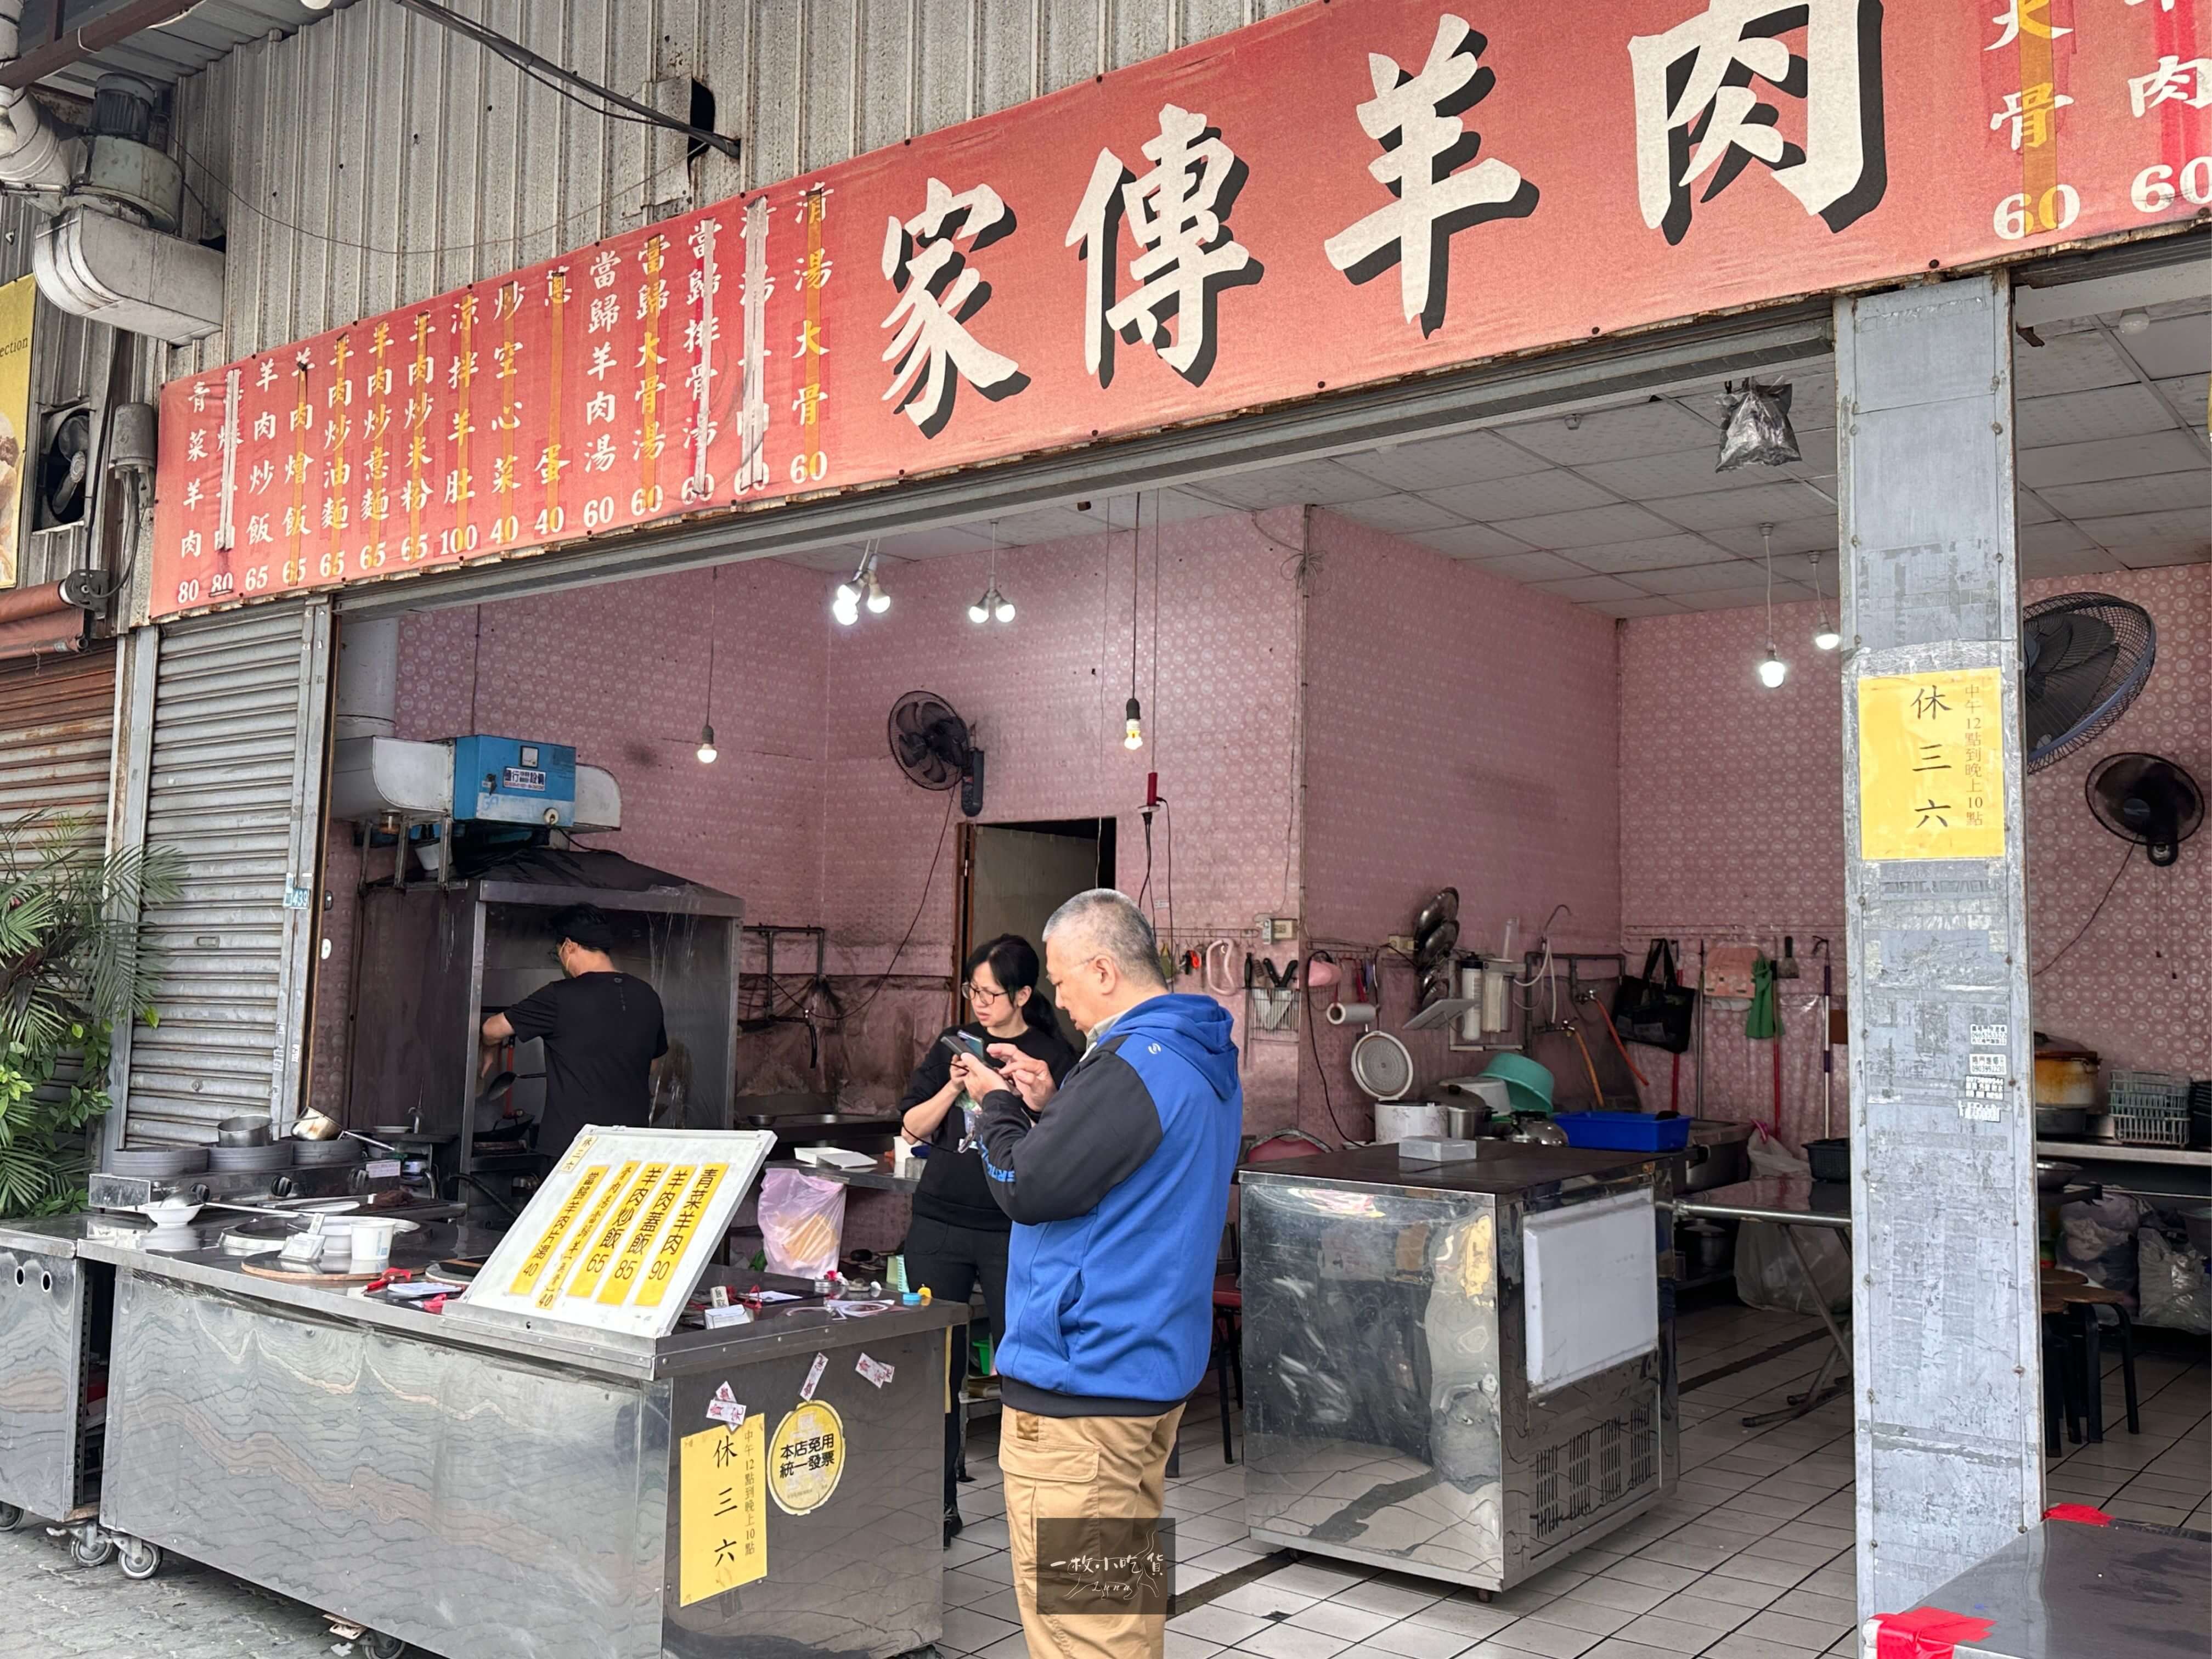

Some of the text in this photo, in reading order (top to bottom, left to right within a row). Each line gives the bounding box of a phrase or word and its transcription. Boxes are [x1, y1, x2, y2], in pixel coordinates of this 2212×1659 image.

[881, 0, 1887, 440] 家傳羊肉
[1993, 184, 2080, 240] 60
[2130, 156, 2211, 213] 60
[440, 292, 479, 554] 涼拌羊肚 100
[490, 281, 526, 543] 炒空心菜 40
[583, 250, 621, 527] 當歸羊肉湯 60
[630, 234, 670, 516] 當歸大骨湯 60
[178, 381, 211, 603] 青菜羊肉 80
[245, 357, 278, 591] 羊肉炒飯 65
[282, 347, 314, 583] 羊肉燴飯 65
[319, 335, 354, 577] 羊肉炒油麵 65
[359, 322, 394, 567] 羊肉炒意麵 65
[400, 312, 436, 562] 羊肉炒米粉 65
[790, 450, 828, 484] 60
[534, 506, 563, 534] 40
[211, 573, 234, 594] 80
[1910, 684, 1953, 828] 休三六
[566, 1136, 594, 1170] 休三六
[523, 1263, 539, 1277] 40
[586, 1167, 662, 1273] 羊肉炒飯 65
[614, 1169, 689, 1280] 羊肉蓋飯 85
[648, 1168, 719, 1282] 青菜羊肉 90
[539, 1293, 554, 1307] 40
[713, 1435, 738, 1567] 休三六
[780, 1433, 834, 1460] 本店免用
[780, 1450, 835, 1479] 統一發票
